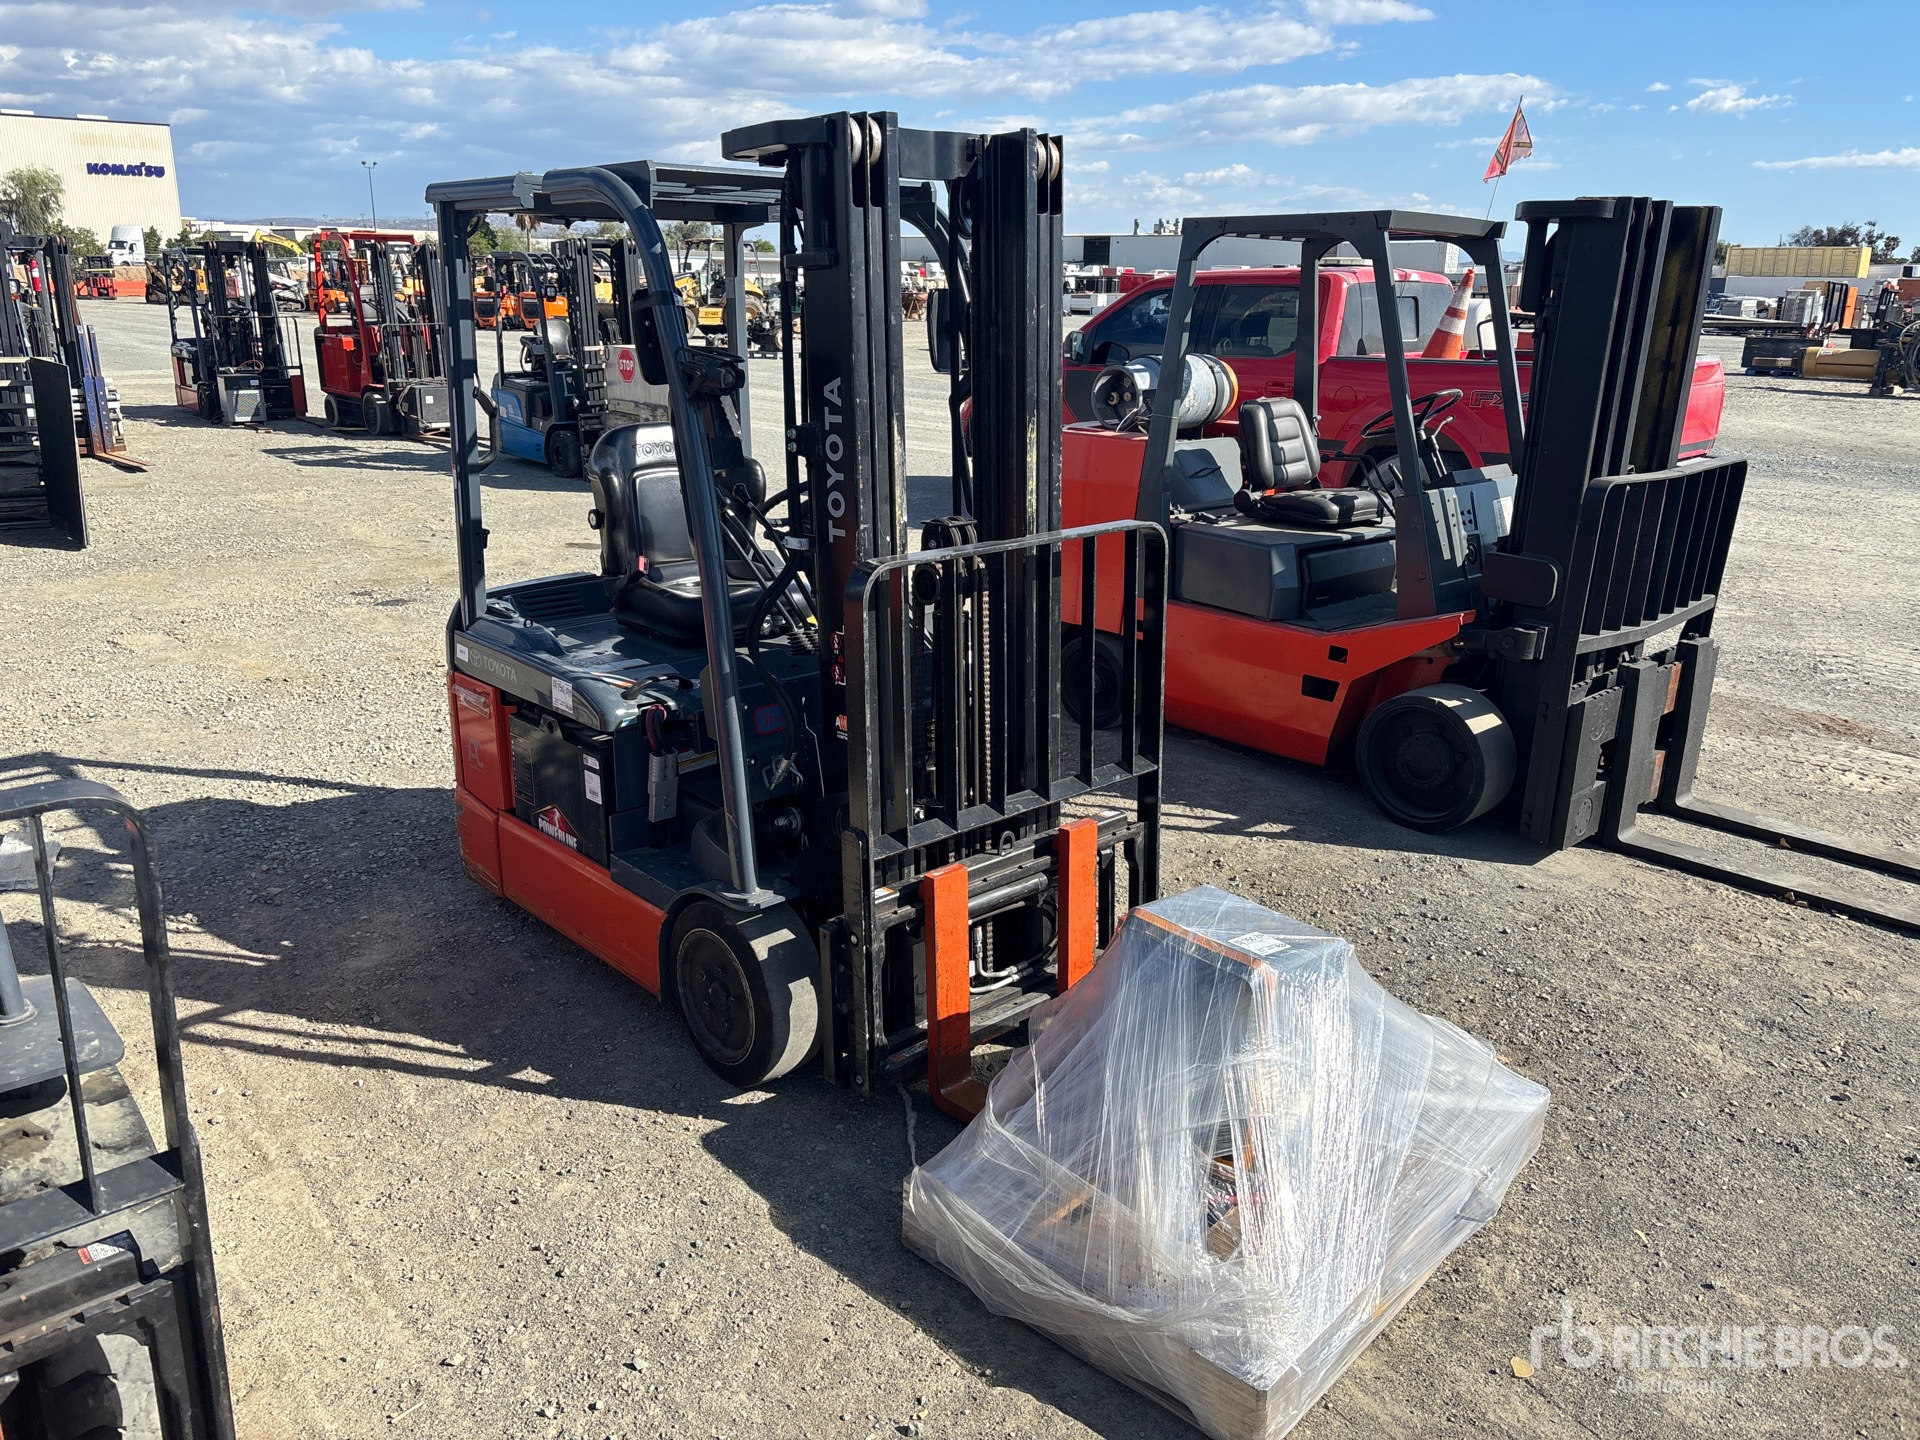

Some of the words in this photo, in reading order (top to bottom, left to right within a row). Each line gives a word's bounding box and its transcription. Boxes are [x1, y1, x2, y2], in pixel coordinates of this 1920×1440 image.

[86, 162, 165, 178] KOMATSU
[619, 359, 634, 371] STOP
[632, 441, 675, 457] TOYO
[823, 376, 846, 543] TOYOTA
[482, 655, 517, 682] TOYOTA
[538, 817, 578, 850] POWERLINE
